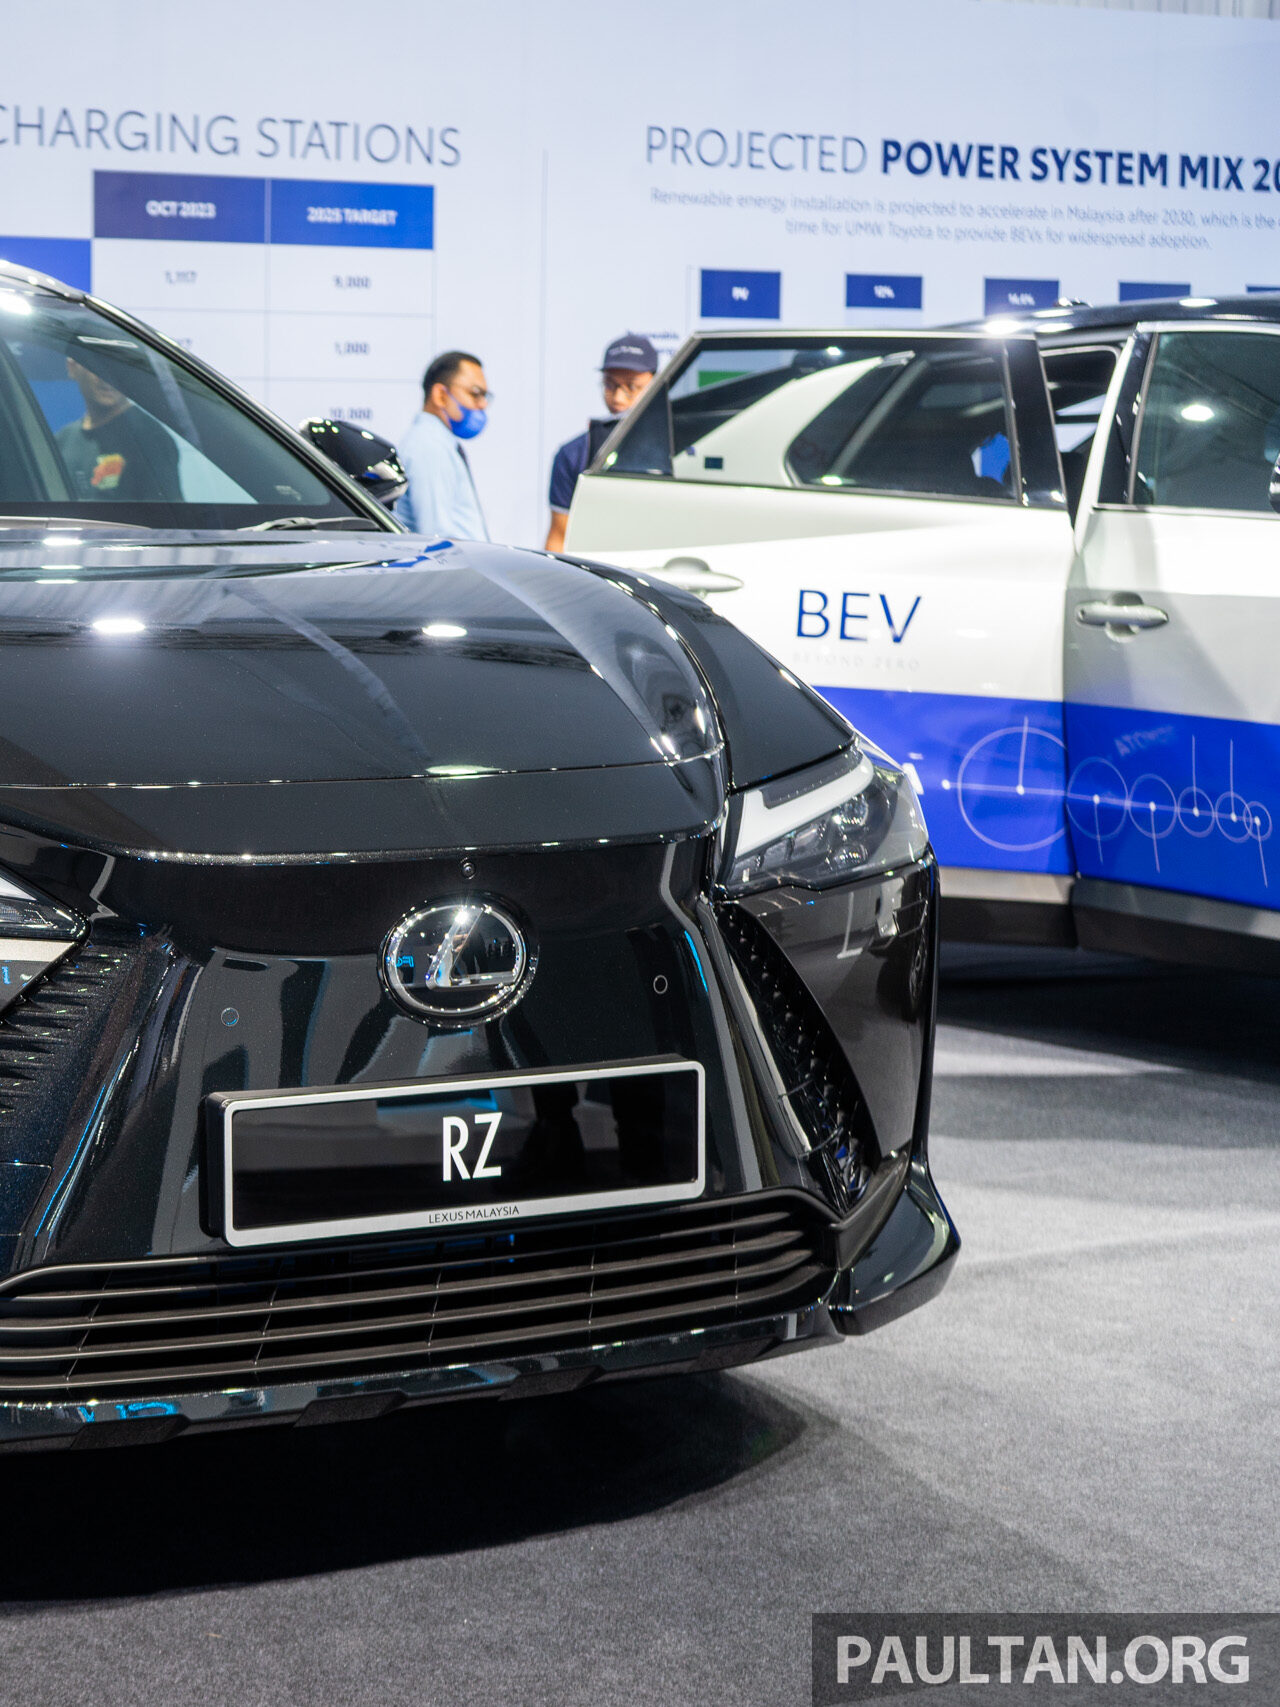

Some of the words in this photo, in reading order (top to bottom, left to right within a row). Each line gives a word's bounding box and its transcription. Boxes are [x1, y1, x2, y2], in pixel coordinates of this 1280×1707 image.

[257, 117, 461, 167] STATIONS
[646, 125, 867, 174] PROJECTED
[881, 138, 1021, 181] POWER
[1029, 146, 1168, 188] SYSTEM
[1178, 153, 1245, 192] MIX
[797, 589, 922, 644] BEV
[442, 1111, 503, 1182] RZ
[428, 1210, 464, 1224] LEXUS
[465, 1204, 520, 1220] MALAYSIA
